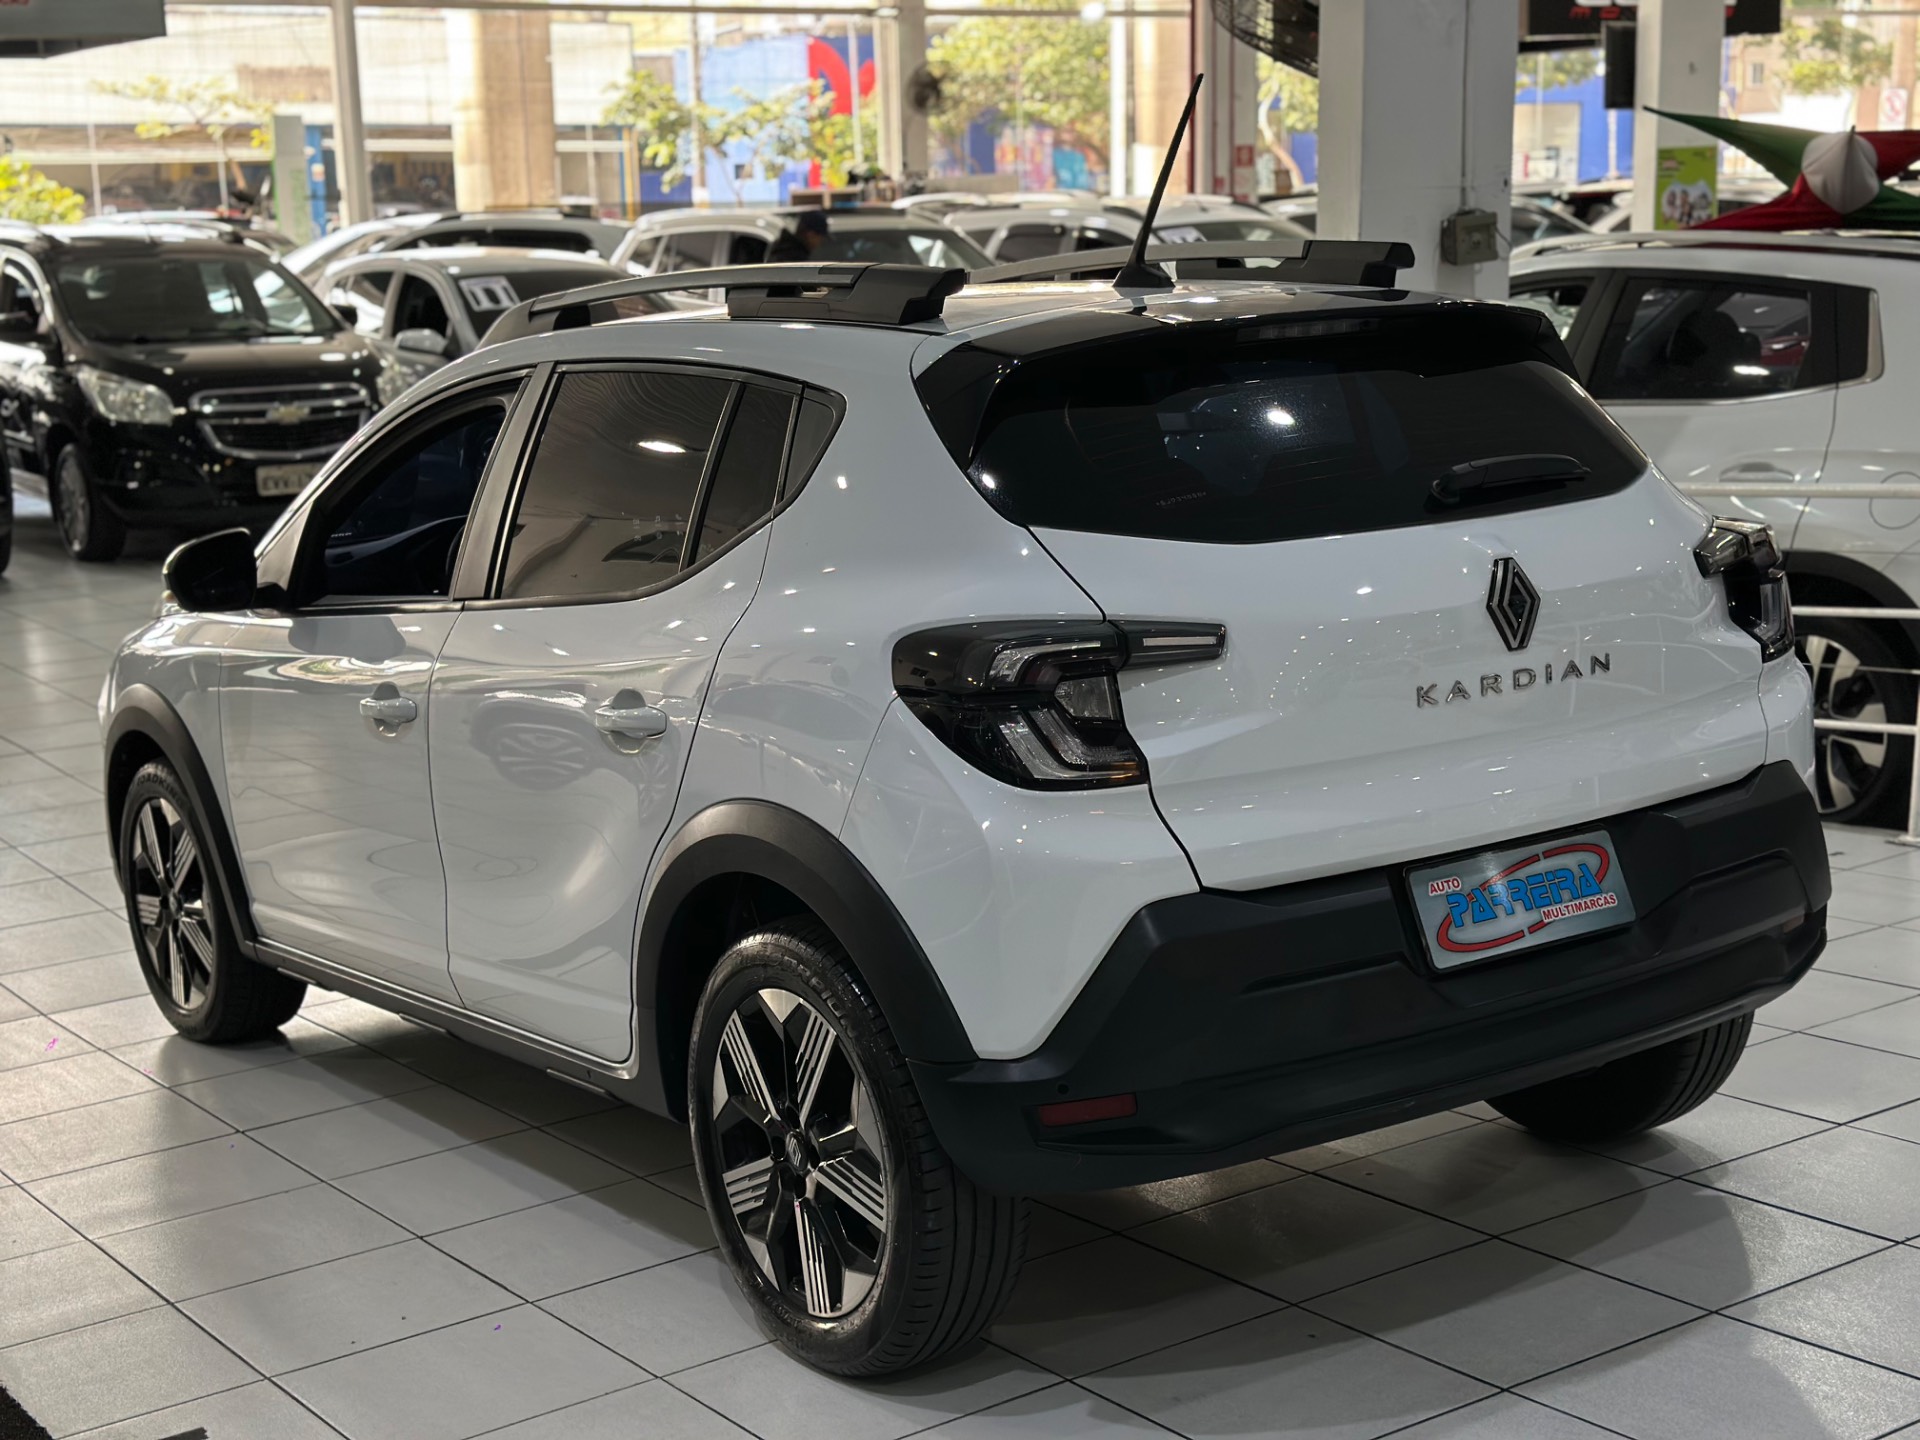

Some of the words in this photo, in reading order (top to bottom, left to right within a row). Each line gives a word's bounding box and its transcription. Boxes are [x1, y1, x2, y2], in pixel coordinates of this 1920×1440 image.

[1416, 653, 1610, 708] KARDIAN
[1429, 877, 1460, 895] AUTO
[1446, 863, 1602, 928] PARREIRA
[1542, 894, 1617, 921] MULTIMARCAS
